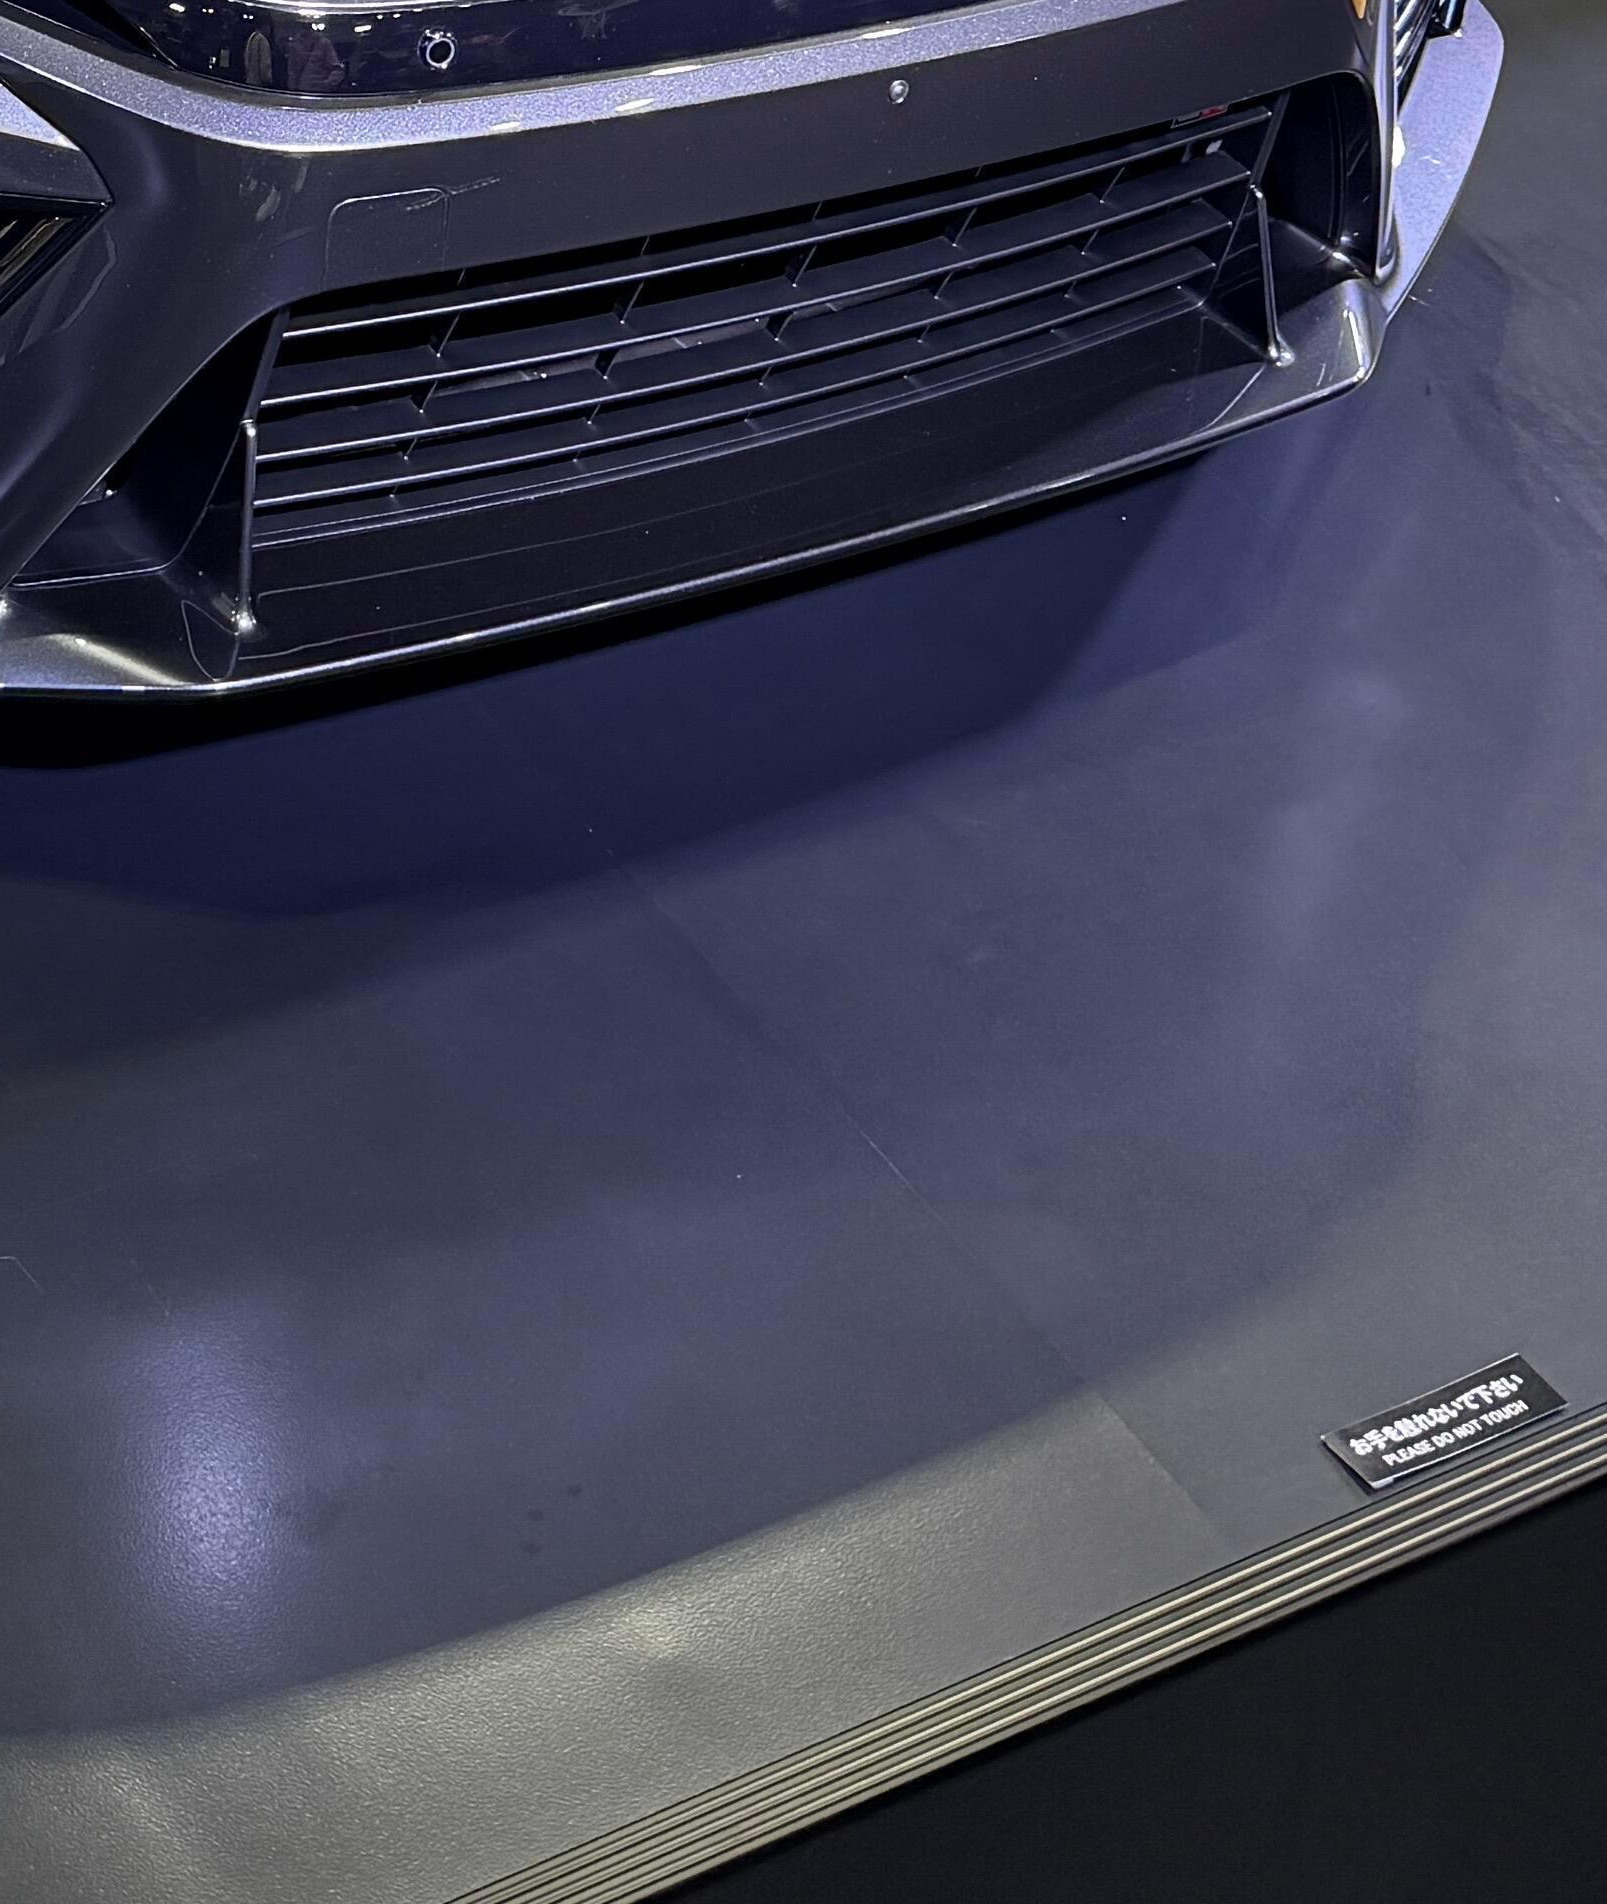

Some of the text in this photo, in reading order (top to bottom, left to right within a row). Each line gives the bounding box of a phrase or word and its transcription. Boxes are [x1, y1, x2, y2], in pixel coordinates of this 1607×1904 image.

[1349, 1373, 1524, 1456] お手を触れないで下さい
[1382, 1399, 1530, 1467] PLEASE DO NOT TOUCH
